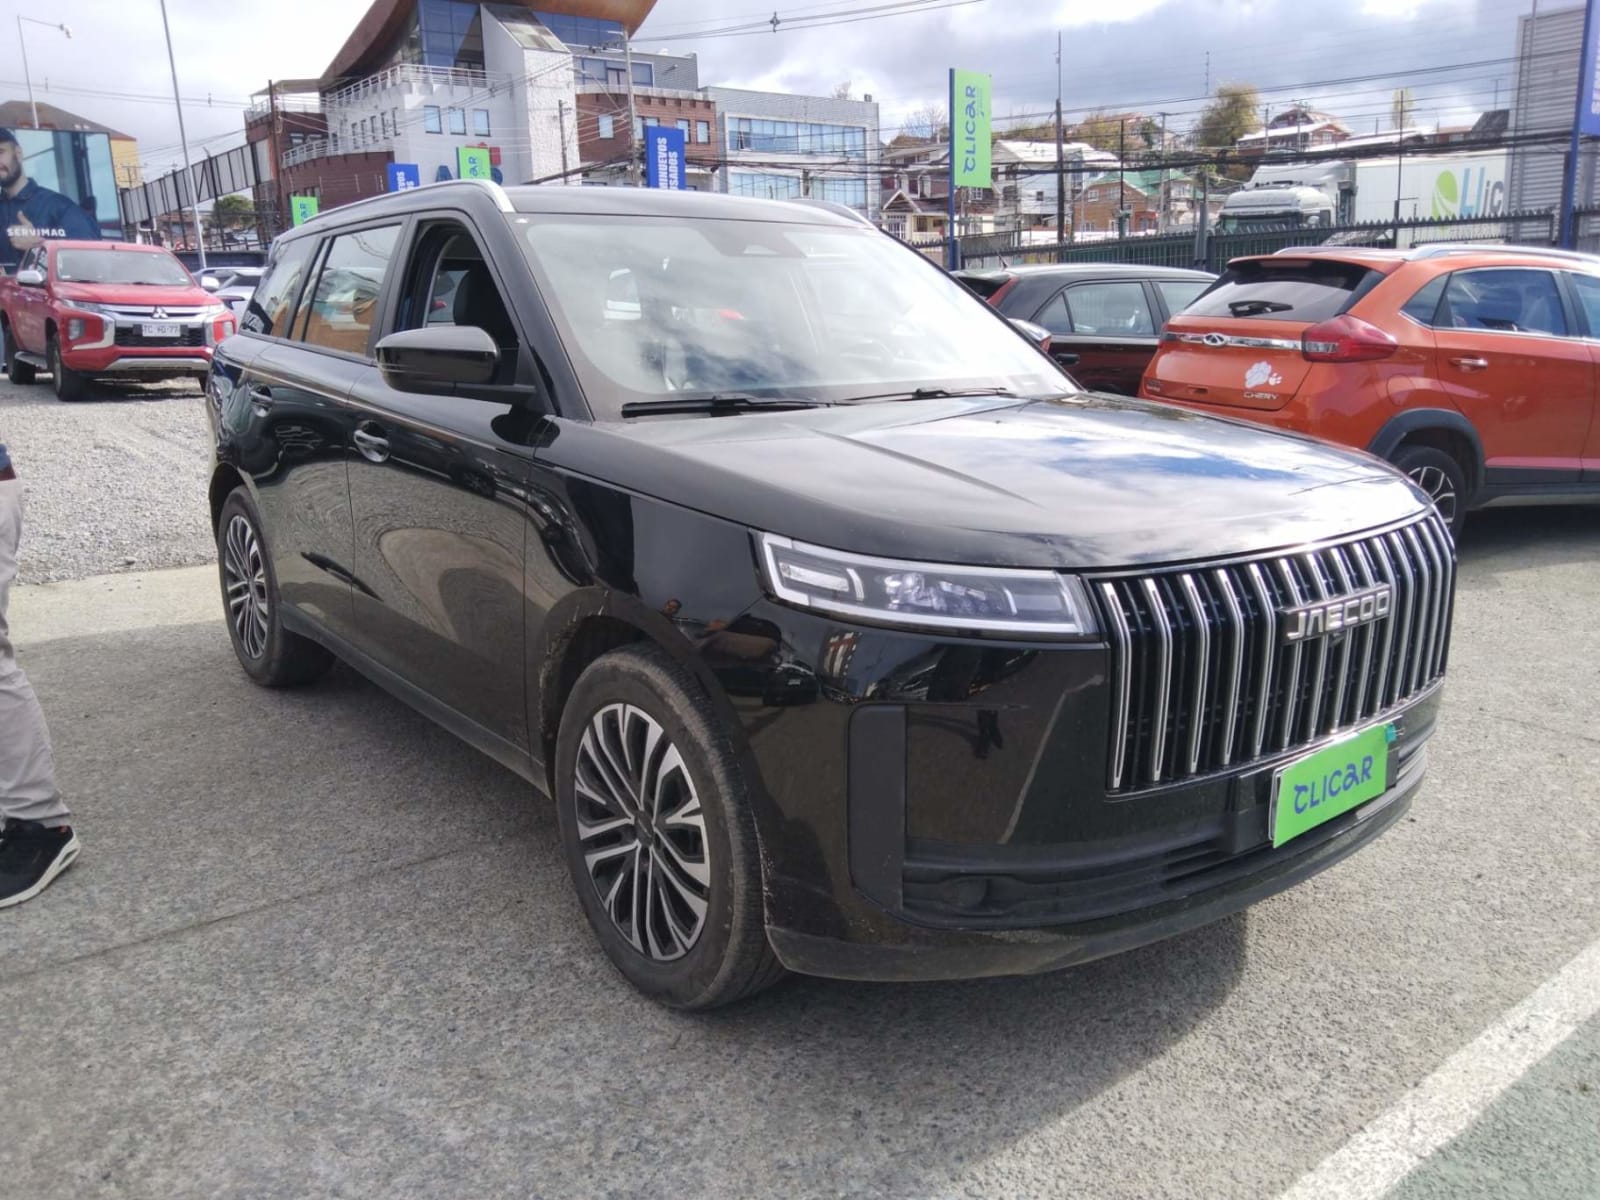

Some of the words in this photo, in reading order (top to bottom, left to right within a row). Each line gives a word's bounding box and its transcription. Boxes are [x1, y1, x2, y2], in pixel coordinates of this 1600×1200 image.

[7, 228, 66, 237] SERVIMAQ
[1243, 391, 1278, 400] CHERY
[1287, 590, 1390, 639] JAECOO
